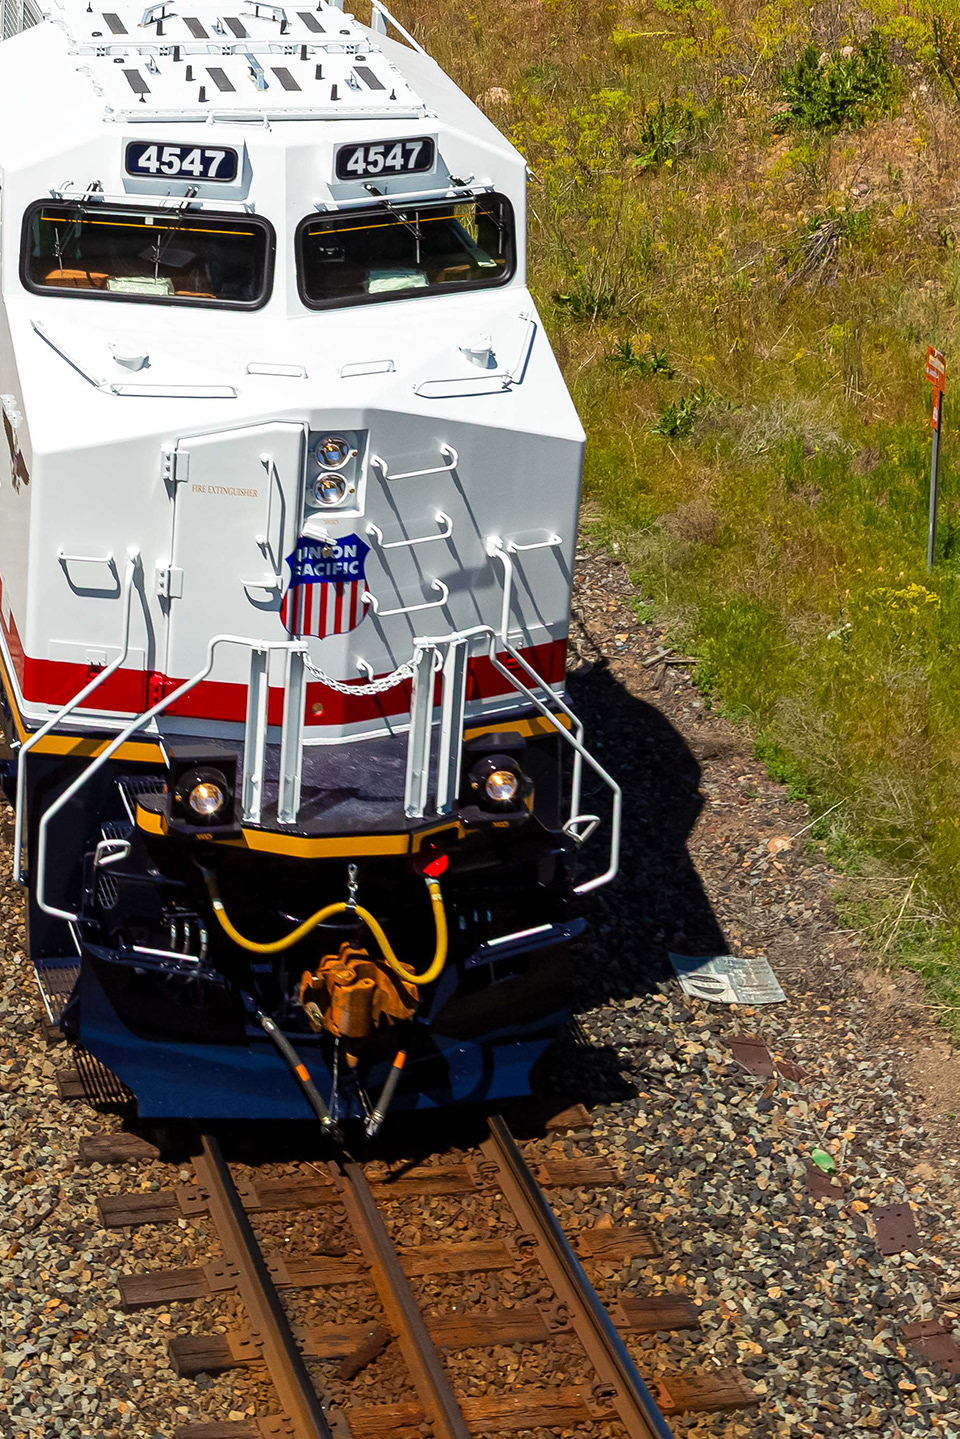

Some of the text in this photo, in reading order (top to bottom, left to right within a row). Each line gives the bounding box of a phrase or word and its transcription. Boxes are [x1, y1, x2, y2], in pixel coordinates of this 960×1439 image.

[138, 145, 226, 177] 4547
[347, 141, 423, 175] 4547
[297, 544, 357, 562] UNON
